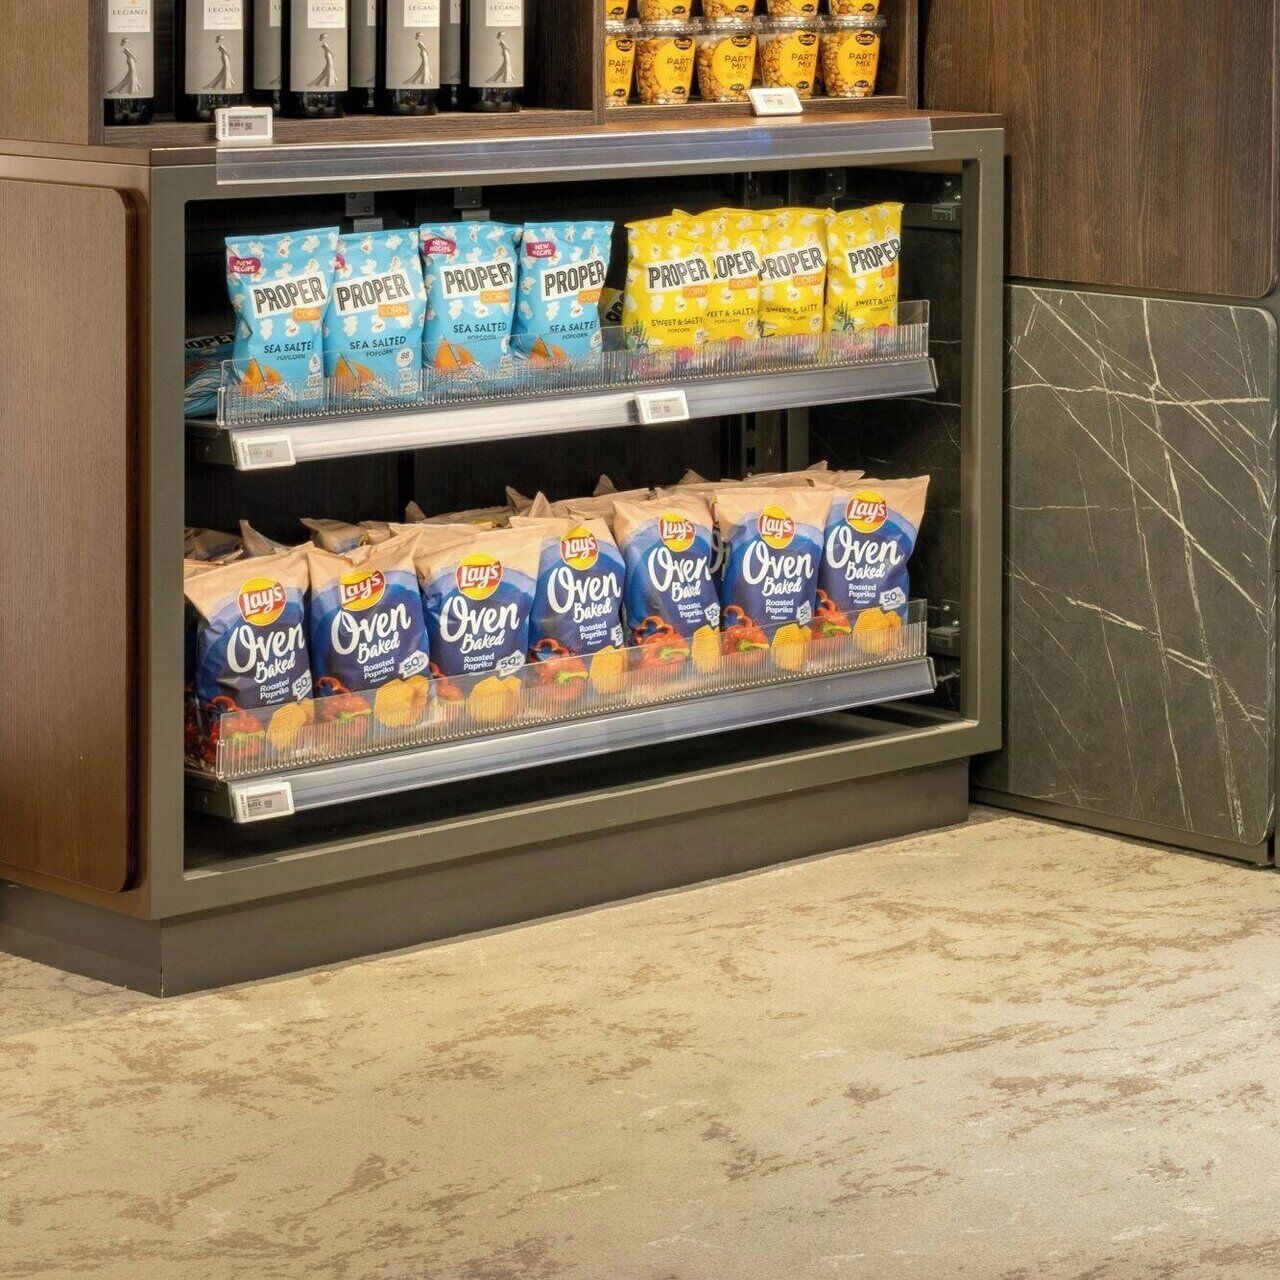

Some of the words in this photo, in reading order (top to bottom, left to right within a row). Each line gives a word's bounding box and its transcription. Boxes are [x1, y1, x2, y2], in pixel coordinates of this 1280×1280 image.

[714, 251, 759, 278] OPER
[758, 247, 825, 281] PROPER
[848, 239, 900, 273] PROPER
[444, 262, 513, 295] PROPER
[545, 260, 605, 296] PROPER
[648, 258, 709, 289] PROPER
[254, 276, 326, 314] PROPER
[337, 274, 411, 311] PROPER
[453, 323, 471, 333] SEA
[474, 322, 506, 332] SALTED
[550, 325, 566, 334] SEA
[264, 344, 281, 353] SEA
[350, 339, 370, 350] SEA
[373, 336, 406, 348] SALTED
[826, 525, 901, 569] Oven
[743, 540, 814, 585] Oven
[844, 560, 886, 581] Baked
[547, 566, 622, 614] Oven
[761, 575, 803, 597] Baked
[848, 583, 877, 591] Roasted
[848, 590, 876, 599] Paprika
[439, 595, 520, 643] Oven
[765, 606, 793, 615] Paprika
[330, 603, 411, 655] Oven
[460, 629, 506, 655] Baked
[227, 623, 306, 674] Oven
[357, 631, 400, 665] Baked
[463, 652, 495, 663] Roasted
[254, 651, 296, 684] Baked
[363, 657, 395, 673] Roasted
[363, 666, 394, 680] Paprika
[463, 661, 493, 671] Paprika
